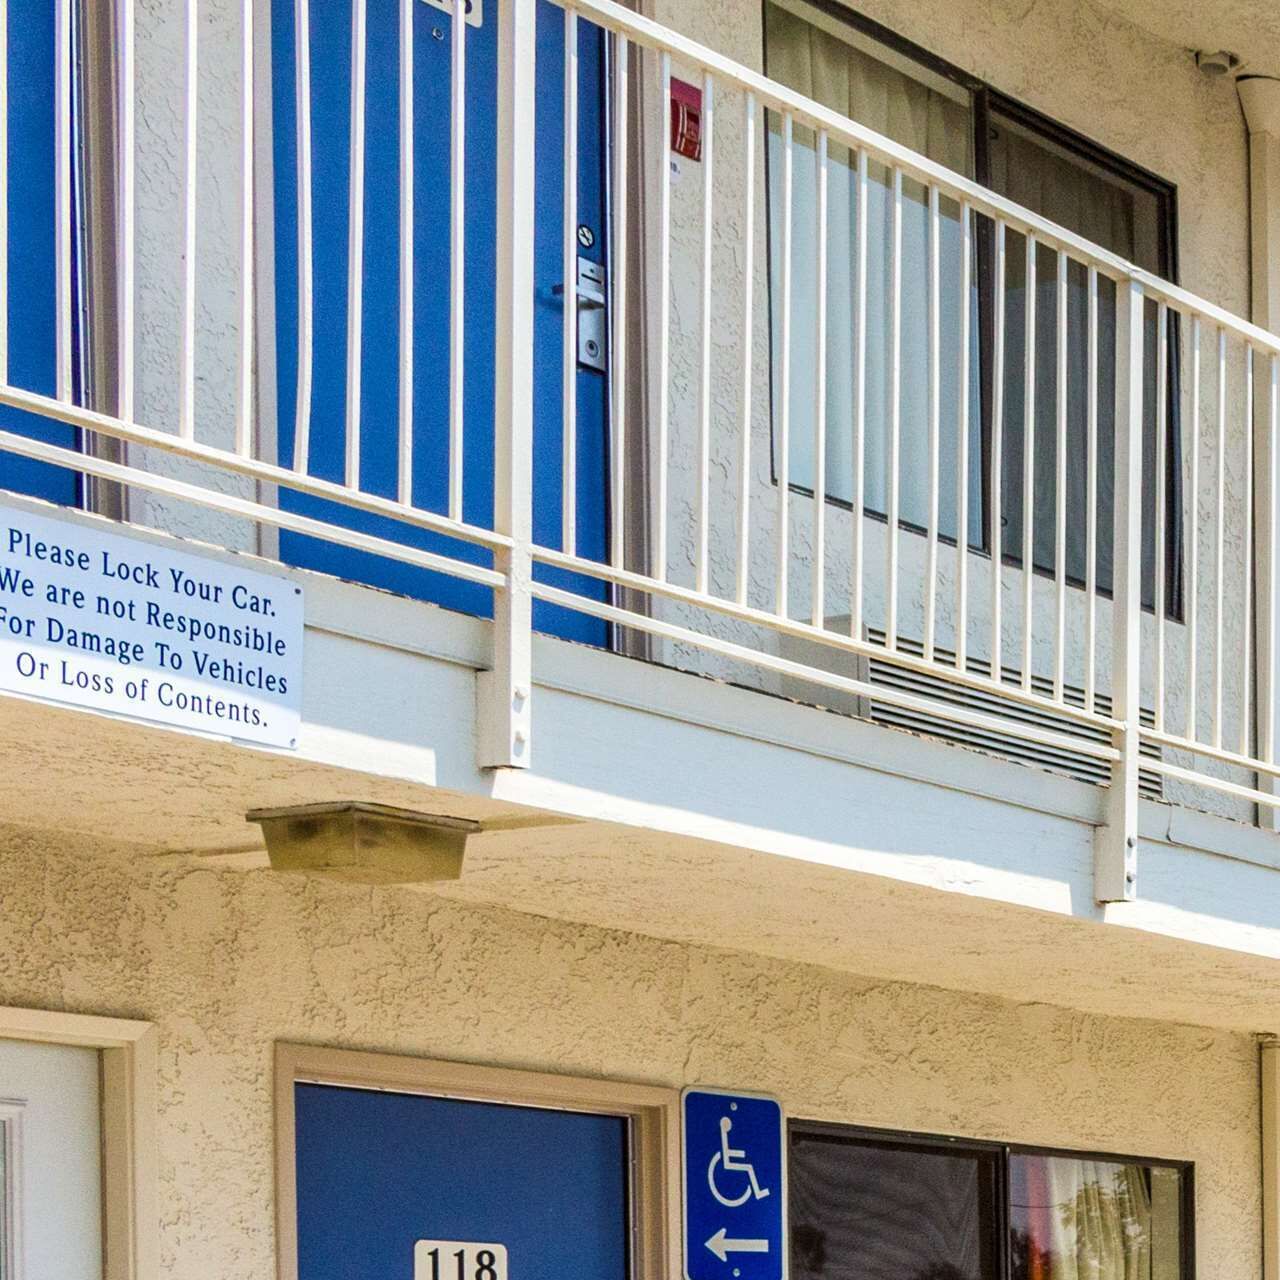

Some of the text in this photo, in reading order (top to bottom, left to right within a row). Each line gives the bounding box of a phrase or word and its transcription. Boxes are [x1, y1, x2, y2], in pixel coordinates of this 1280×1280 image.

[0, 567, 286, 657] We are not Responsible
[8, 528, 276, 617] Please Lock Your Car.
[16, 652, 268, 728] Or Loss of Contents.
[46, 618, 144, 665] Damage
[155, 643, 182, 670] To
[193, 651, 288, 695] Vehicles
